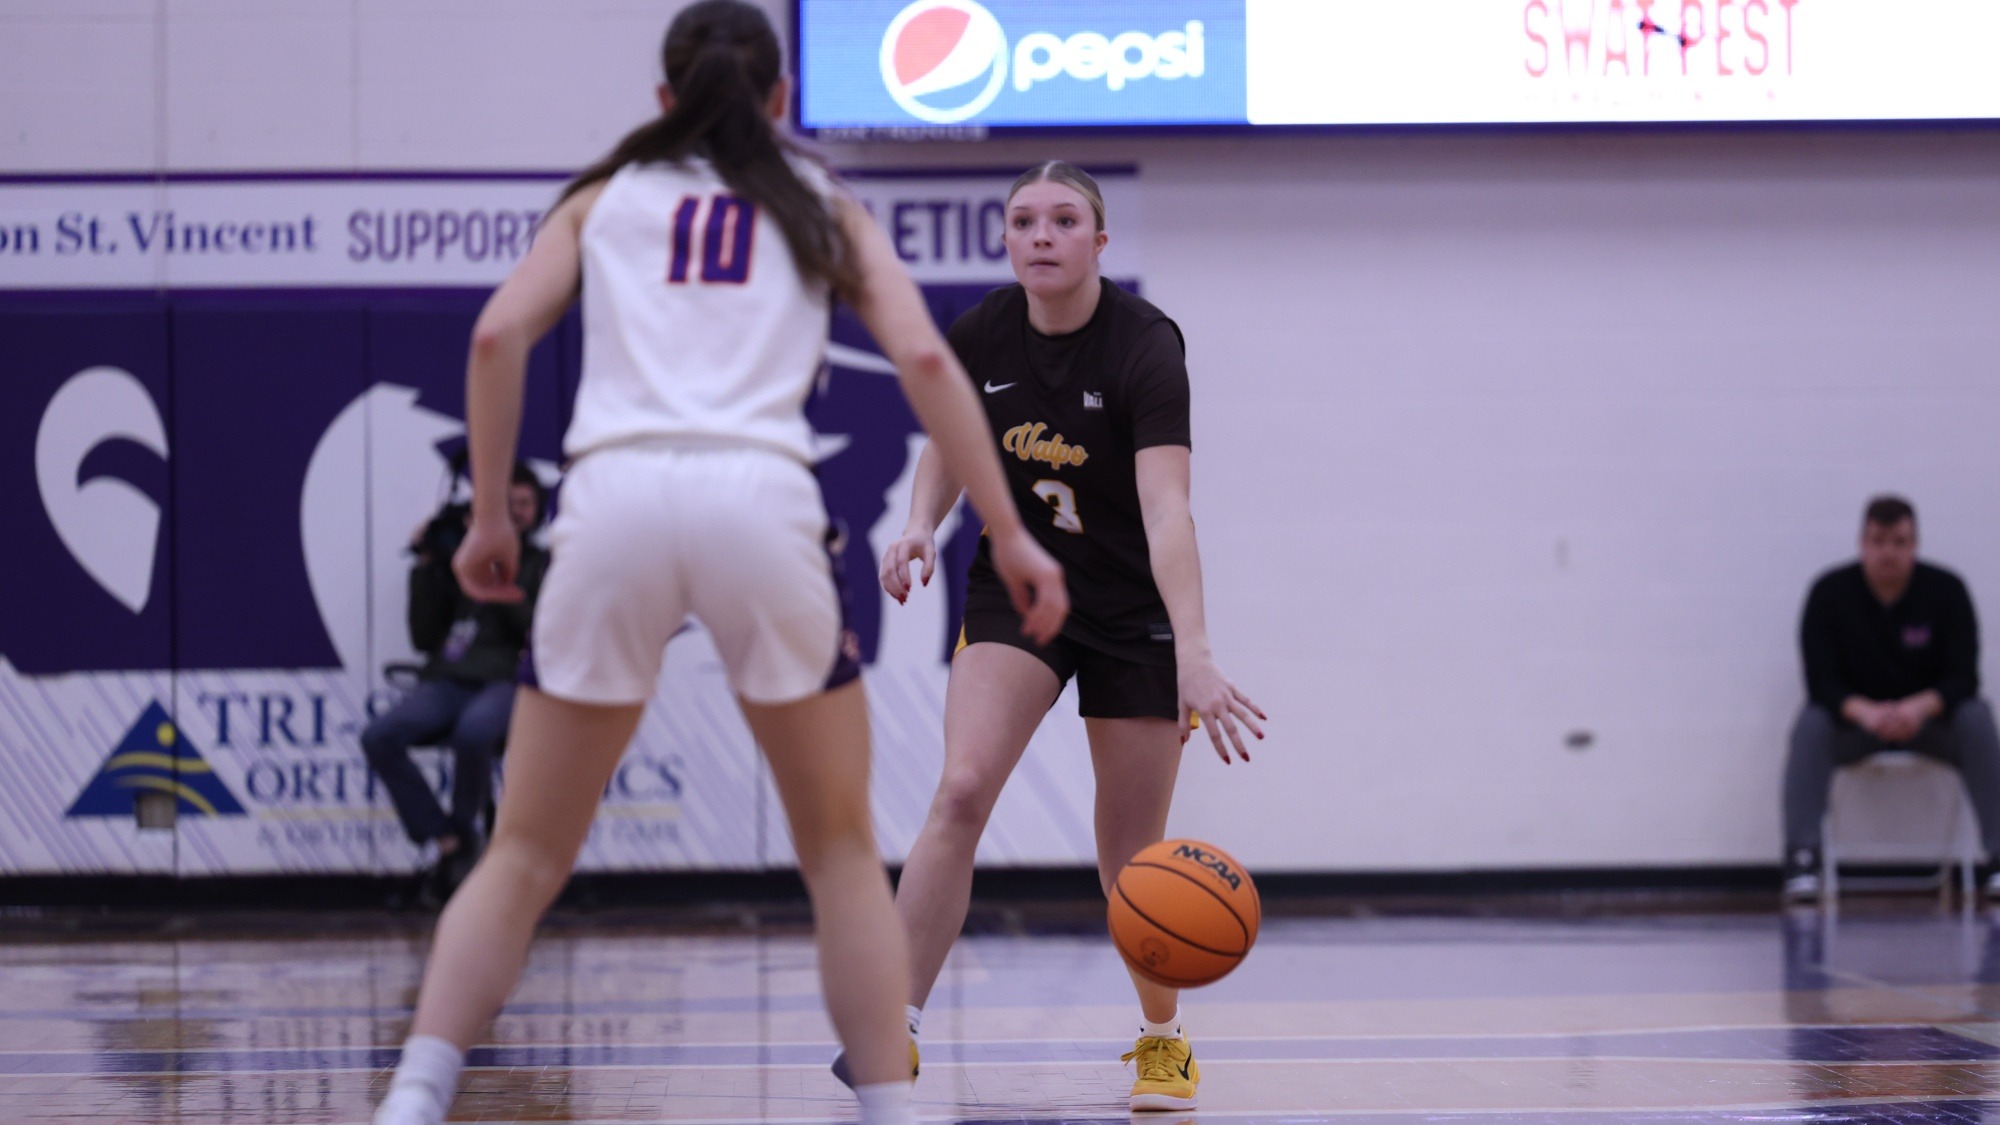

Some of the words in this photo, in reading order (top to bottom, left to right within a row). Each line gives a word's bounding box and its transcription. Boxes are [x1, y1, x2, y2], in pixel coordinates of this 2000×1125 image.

[1013, 20, 1205, 91] pepsi
[1524, 0, 1654, 77] SWAT
[1679, 0, 1798, 76] PEST
[54, 212, 118, 256] St.
[125, 211, 319, 254] Vincent
[667, 194, 757, 284] 10
[1002, 421, 1089, 470] Valpo
[1031, 478, 1084, 534] 3
[1172, 844, 1242, 892] NCAA
